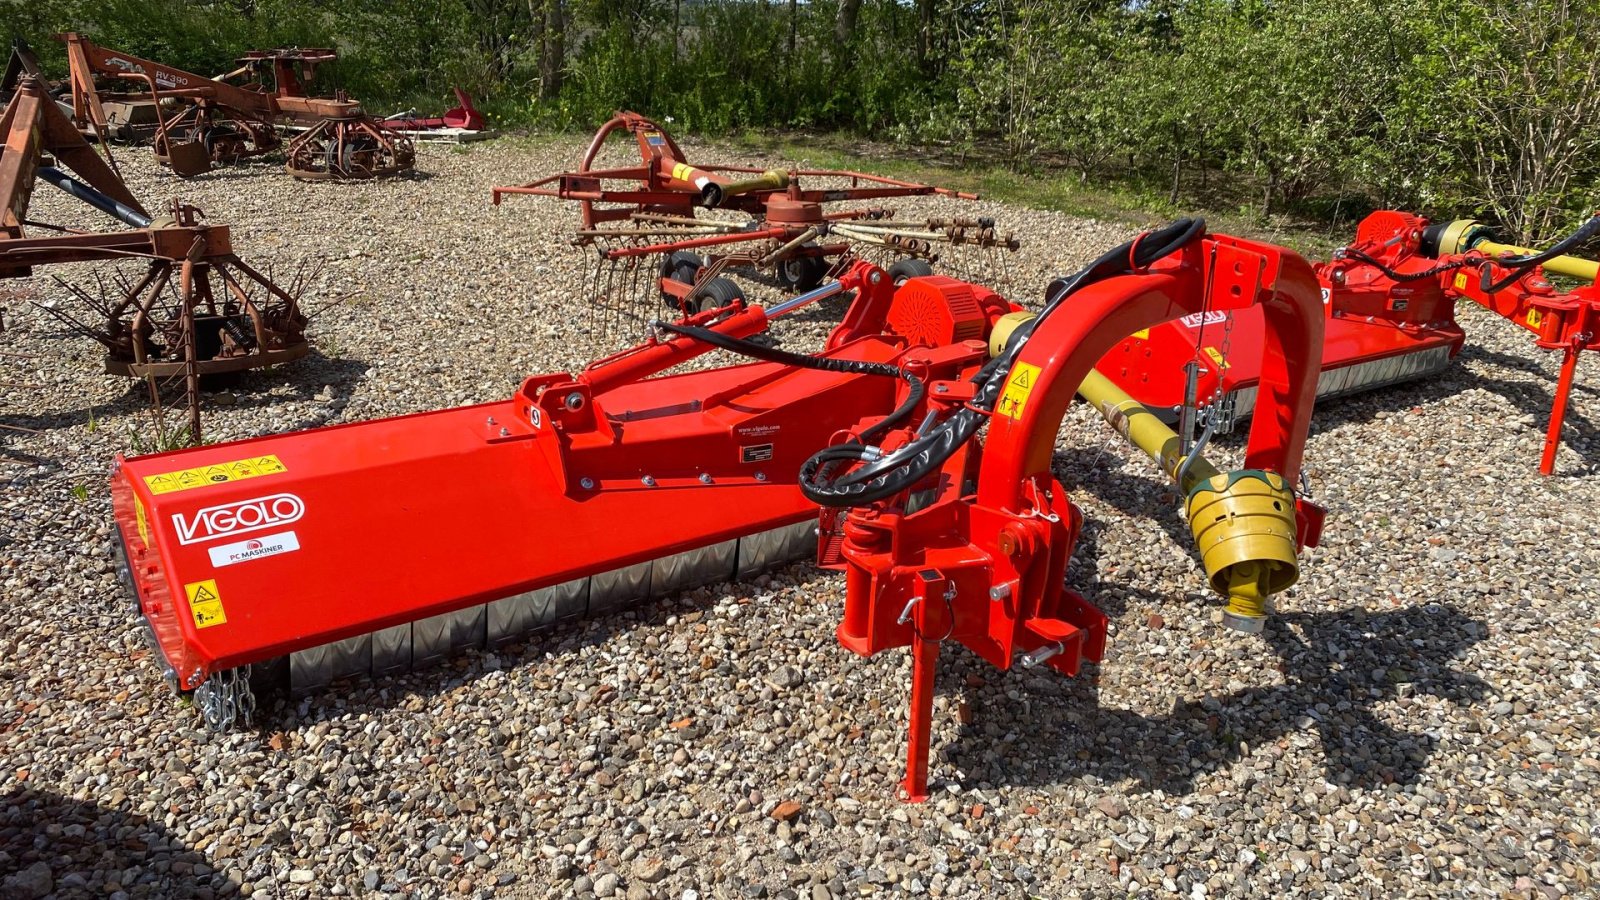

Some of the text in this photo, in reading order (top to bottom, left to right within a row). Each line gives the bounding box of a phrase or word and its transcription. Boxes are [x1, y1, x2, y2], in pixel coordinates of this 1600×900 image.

[155, 70, 169, 80] RV
[169, 74, 189, 86] 390
[172, 494, 304, 545] VIGOLO
[229, 553, 241, 561] PC
[241, 544, 284, 559] MASKINER
